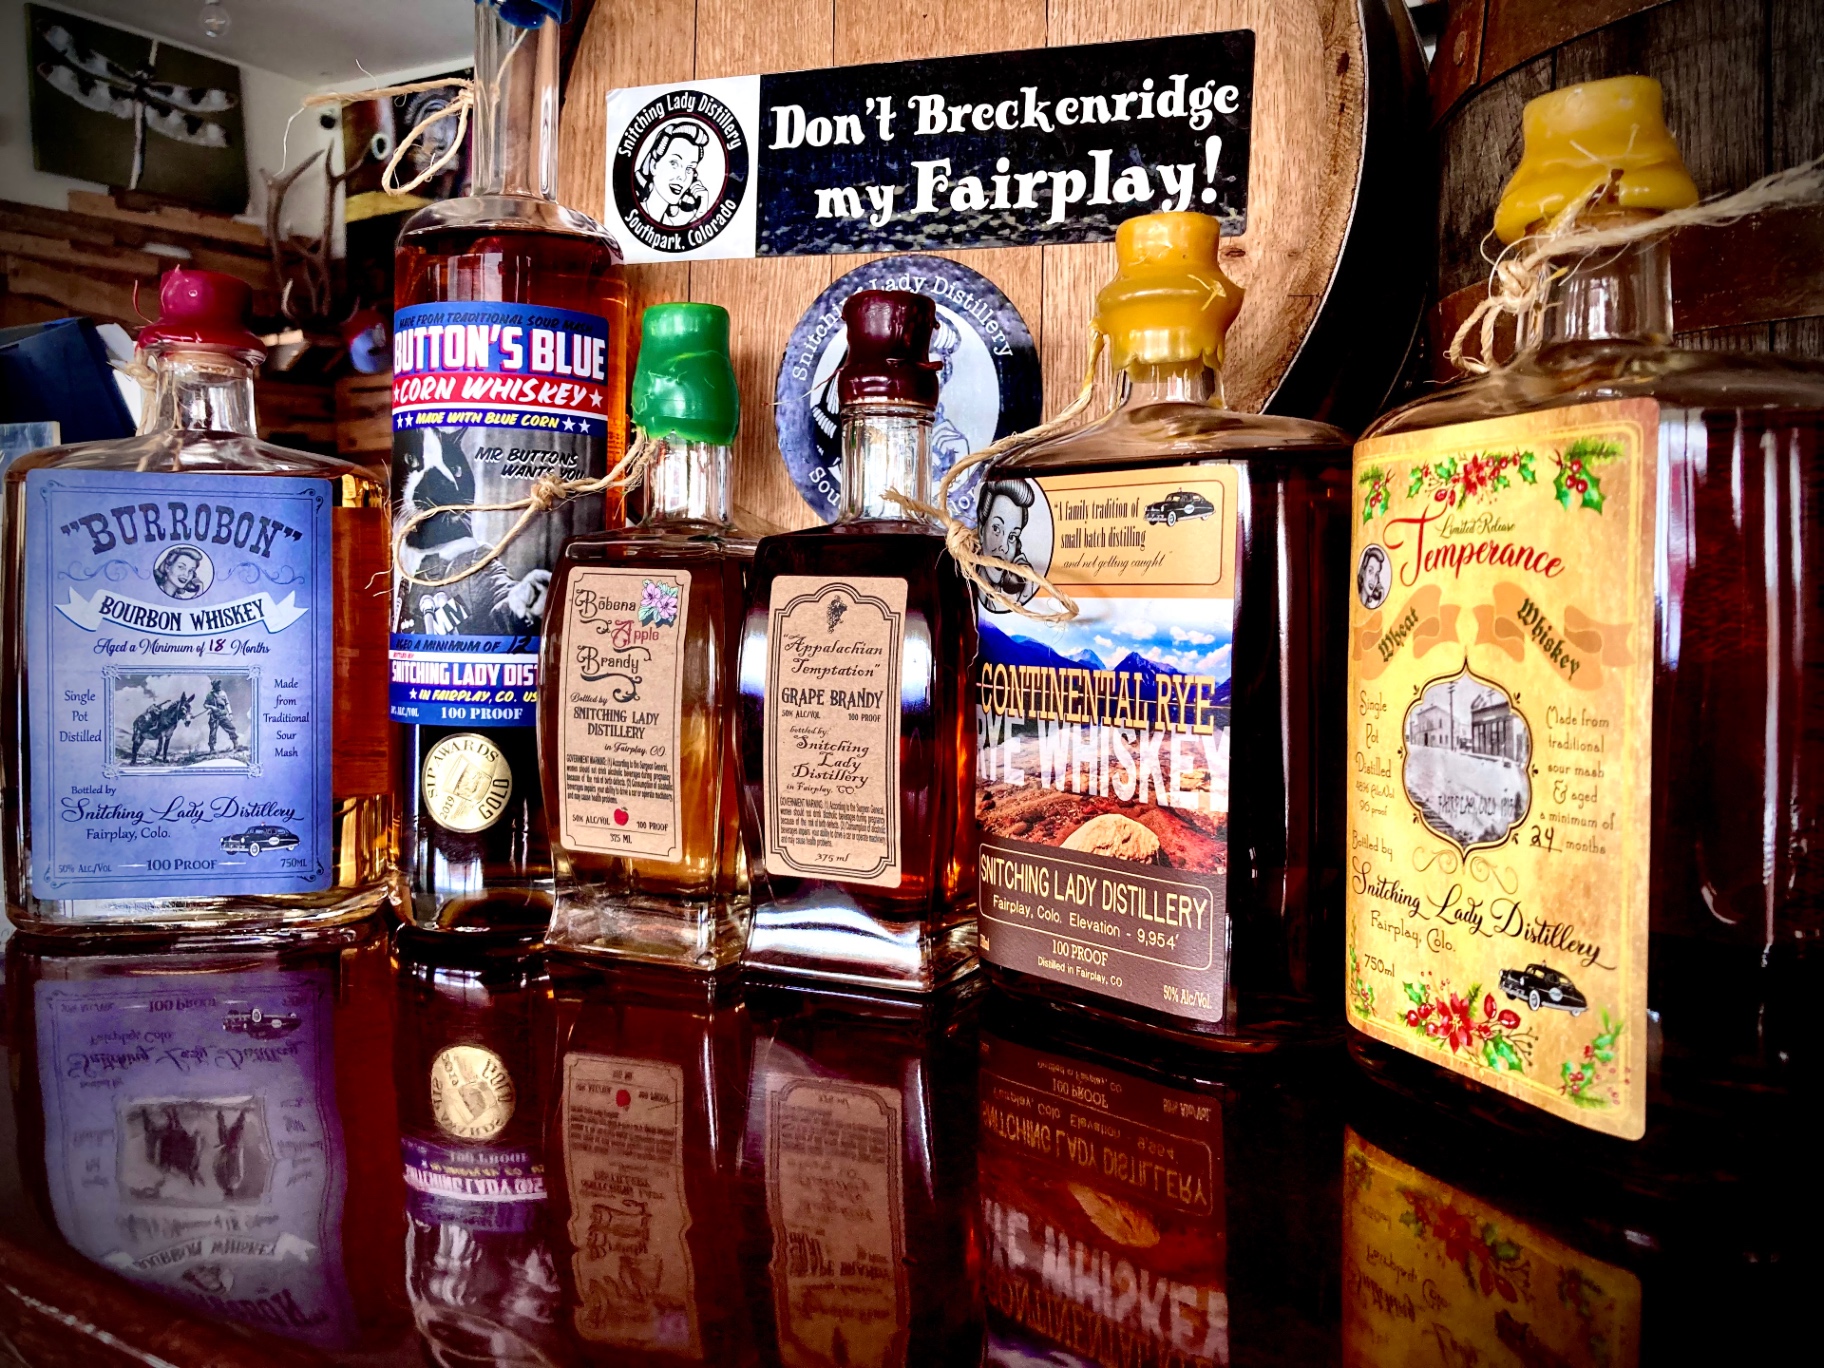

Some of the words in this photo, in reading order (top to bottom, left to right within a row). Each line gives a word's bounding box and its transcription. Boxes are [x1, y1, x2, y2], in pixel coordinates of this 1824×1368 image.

[768, 96, 893, 149] Don't
[908, 73, 1239, 136] Breckenridge
[618, 107, 665, 158] Snitching
[666, 96, 697, 114] Lady
[697, 95, 742, 149] Distillery
[816, 182, 893, 226] my
[911, 134, 1222, 224] Fairplay!
[687, 197, 736, 249] Colorado
[400, 316, 414, 329] MADE
[416, 314, 444, 325] FROM
[446, 312, 522, 324] TRADITIONAL
[527, 316, 559, 328] SOUR
[563, 321, 593, 332] MASH
[869, 273, 926, 293] Lady
[933, 276, 1013, 358] Distillery
[394, 325, 524, 373] BUTTON'S
[532, 330, 605, 381] BLUE
[399, 377, 457, 402] CORN
[461, 376, 587, 407] WHISKEY
[416, 411, 445, 425] MADE
[447, 411, 483, 425] WITH
[485, 412, 518, 426] BLUE
[521, 414, 560, 429] CORN
[474, 447, 503, 463] MR
[507, 448, 578, 468] BUTTONS
[1065, 500, 1088, 524] family
[1092, 497, 1127, 519] tradition
[1131, 497, 1140, 518] of
[1435, 513, 1476, 539] Limited
[1477, 512, 1516, 536] Release
[1061, 528, 1082, 548] small
[1084, 527, 1106, 548] batch
[1108, 526, 1146, 551] distilling
[1383, 503, 1565, 586] Temperance
[1064, 553, 1085, 568] and
[1098, 555, 1129, 577] getting
[99, 596, 181, 631] BOURBON
[191, 598, 265, 631] WHISKEY
[423, 640, 481, 651] MINIMUM
[483, 641, 501, 651] OF
[611, 620, 659, 648] Apple
[783, 633, 883, 658] "Appalachian
[1378, 606, 1419, 662] Wheat
[1517, 598, 1580, 680] Whiskey
[94, 638, 126, 654] Aged
[139, 638, 194, 654] Minimum
[195, 642, 205, 657] of
[209, 638, 224, 652] 18
[231, 639, 271, 655] Months
[577, 645, 639, 675] Brandy
[791, 658, 880, 679] Temptation"
[274, 679, 298, 689] Made
[392, 661, 450, 685] SNITCHING
[453, 663, 501, 686] LADY
[64, 690, 95, 703] Single
[276, 695, 297, 709] from
[419, 689, 430, 699] IN
[432, 690, 492, 704] FAIRPLAY,
[495, 691, 517, 702] CO.
[570, 692, 597, 704] Bottled
[599, 697, 608, 706] by
[781, 687, 824, 707] GRAPE
[830, 689, 884, 710] BRANDY
[981, 662, 1150, 728] CONTINENTAL
[1155, 673, 1215, 735] RYE
[1359, 690, 1387, 721] Single
[72, 710, 88, 722] Pot
[263, 712, 309, 724] Traditional
[441, 707, 466, 719] 100
[470, 708, 523, 719] PROOF
[573, 706, 628, 723] SNITCHING
[632, 710, 660, 726] LADY
[782, 710, 793, 718] 50%
[795, 710, 820, 719] ALC/VOL
[861, 714, 881, 722] PROOF
[1546, 705, 1578, 727] Made
[1581, 709, 1609, 728] from
[59, 730, 102, 743] Distilled
[276, 730, 297, 740] Sour
[587, 722, 646, 740] DISTILLERY
[790, 725, 817, 735] bottled
[1365, 723, 1379, 749] Pot
[274, 747, 298, 757] Mash
[613, 742, 647, 756] Fairplay,
[793, 735, 869, 758] Snitching
[1549, 733, 1604, 754] traditional
[426, 767, 437, 798] SIP
[434, 740, 499, 765] AWARDS
[818, 752, 861, 772] Lady
[976, 703, 1026, 786] RYE
[1036, 717, 1230, 813] WHISKEY
[1356, 751, 1392, 779] Distilled
[1548, 763, 1570, 774] sour
[1574, 761, 1604, 778] mash
[792, 764, 868, 788] Distillery
[71, 785, 103, 795] Bottled
[105, 785, 116, 797] by
[478, 779, 509, 819] GOLD
[796, 782, 832, 796] Fairplay,
[1573, 789, 1598, 805] aged
[61, 797, 154, 822] Snitching
[151, 796, 212, 823] Lady
[210, 797, 304, 822] Distillery
[440, 796, 455, 820] 2019
[1360, 800, 1370, 812] 96
[1371, 805, 1387, 818] proof
[573, 814, 583, 822] 50%
[586, 816, 610, 825] ALC/VOL
[637, 821, 646, 829] 100
[649, 821, 668, 831] PROOF
[1549, 811, 1599, 830] minimum
[86, 828, 137, 841] Fairplay,
[141, 828, 170, 839] Colo.
[610, 833, 621, 842] 375
[1352, 829, 1380, 854] Bottled
[1529, 827, 1556, 853] 24
[1565, 837, 1607, 856] months
[59, 864, 75, 873] 50%
[147, 859, 170, 871] 100
[174, 859, 217, 870] PROOF
[815, 853, 834, 863] 375
[836, 852, 850, 863] ml
[980, 853, 1050, 898] SNITCHING
[1054, 871, 1098, 907] LADY
[1102, 880, 1207, 930] DISTILLERY
[993, 894, 1034, 919] Fairplay,
[1037, 906, 1062, 924] Colo.
[1070, 914, 1120, 938] Elevation
[1137, 928, 1180, 950] 9,954'
[1352, 855, 1430, 921] Snitching
[1427, 883, 1493, 938] Lady
[1490, 897, 1617, 971] Distillery
[1370, 910, 1422, 948] Fairplay,
[1426, 928, 1456, 953] Colo.
[1052, 939, 1069, 956] 100
[1071, 944, 1109, 967] PROOF
[1038, 956, 1065, 973] Distilled
[1076, 967, 1108, 985] Fairplay,
[1110, 976, 1122, 987] CO
[1364, 953, 1395, 979] 750ml
[1163, 985, 1178, 1002] 50%
[1180, 990, 1212, 1009] Alc/Vol.
